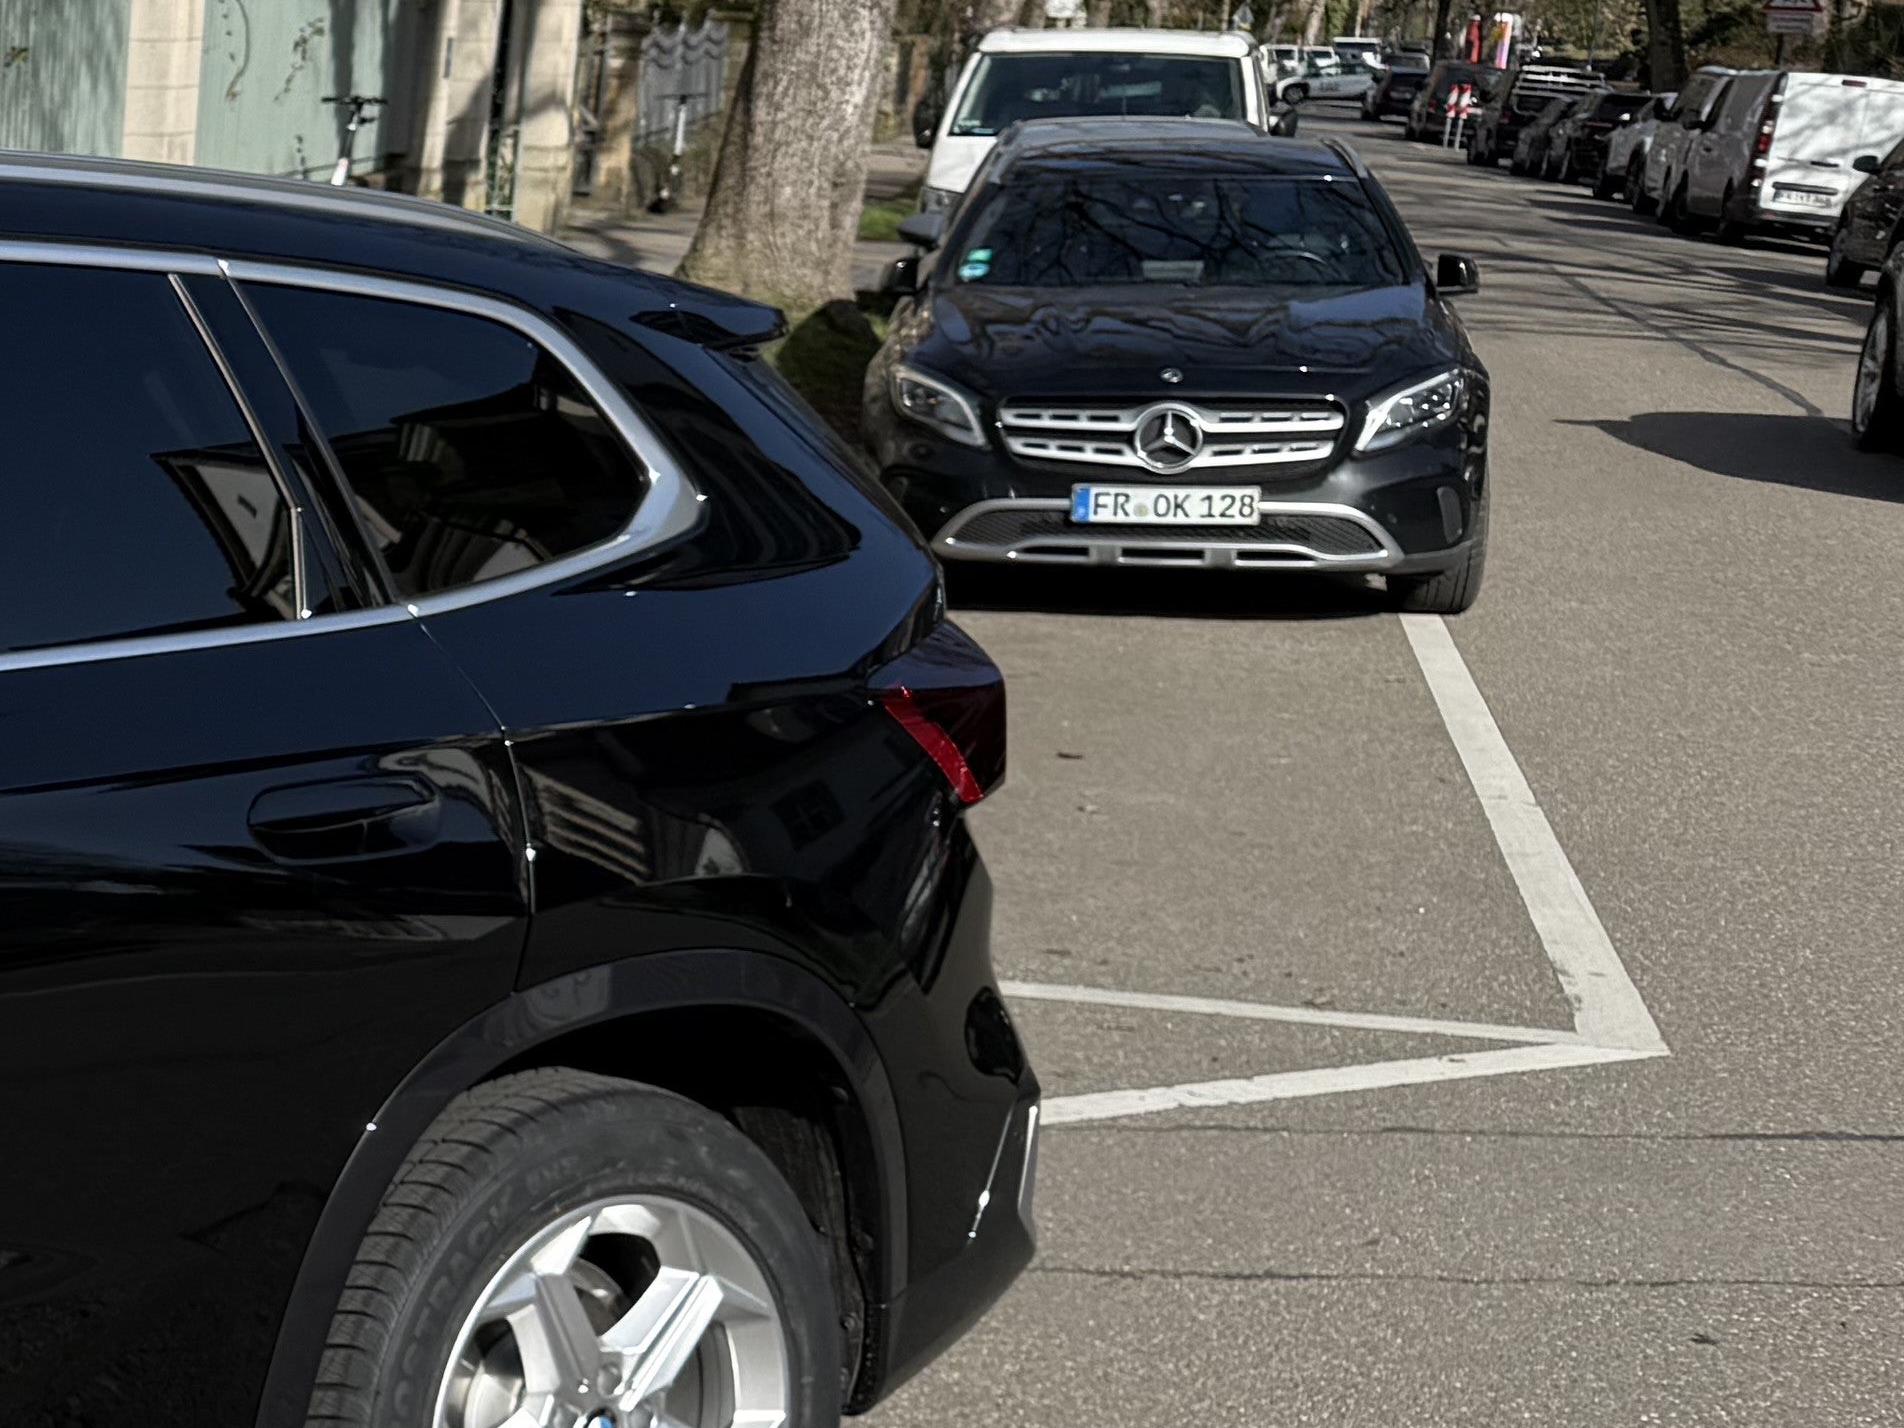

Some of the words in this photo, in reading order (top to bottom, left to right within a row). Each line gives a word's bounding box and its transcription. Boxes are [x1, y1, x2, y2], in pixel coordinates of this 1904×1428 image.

[1092, 492, 1130, 517] FR
[1153, 494, 1193, 518] OK
[1199, 494, 1256, 519] 128
